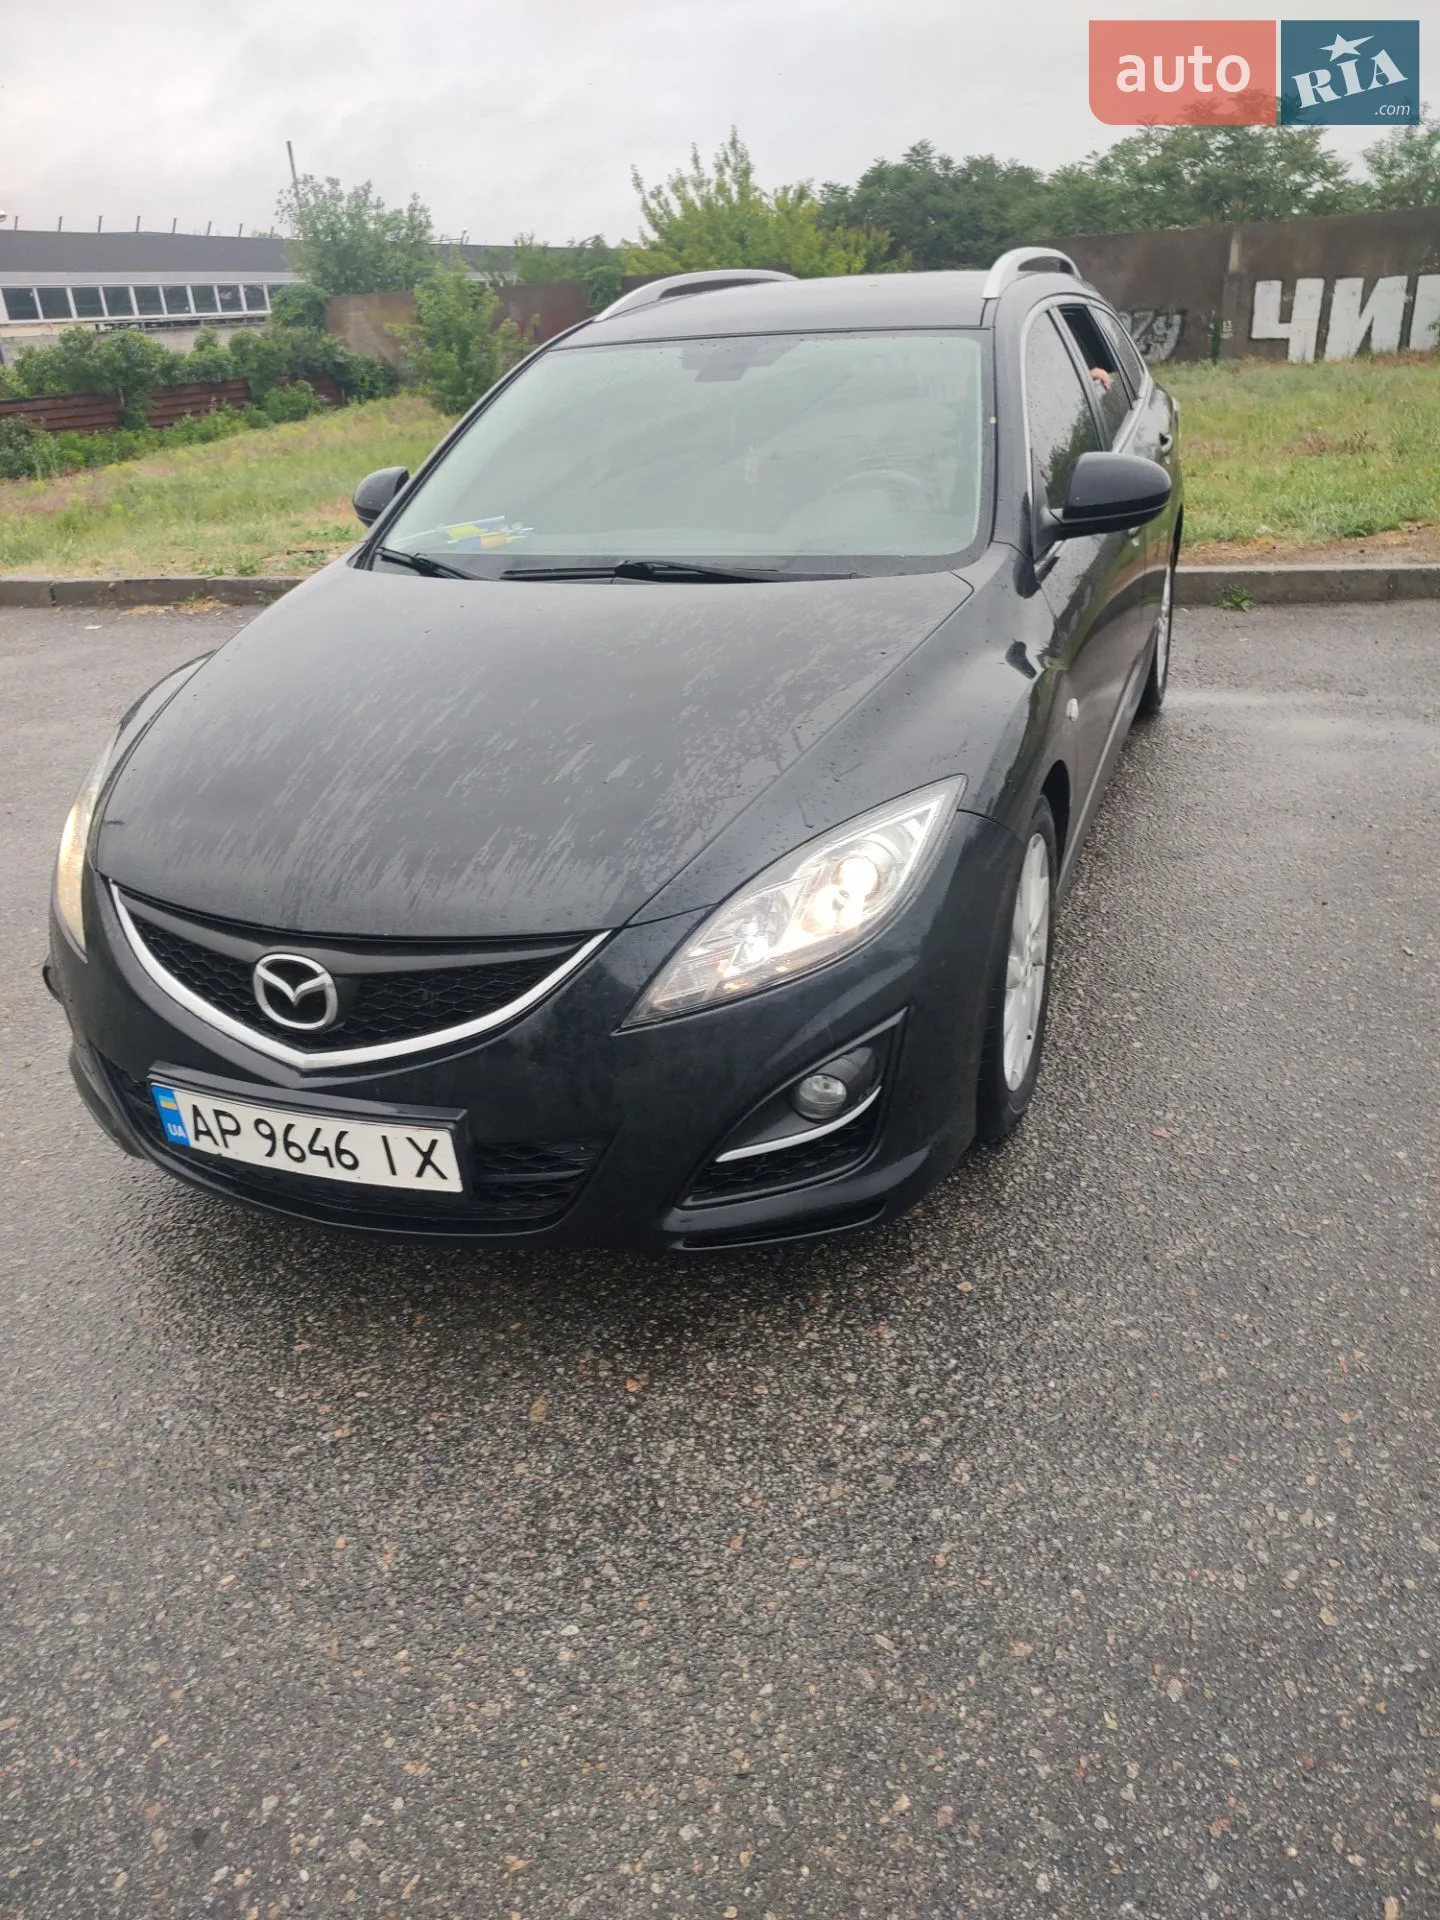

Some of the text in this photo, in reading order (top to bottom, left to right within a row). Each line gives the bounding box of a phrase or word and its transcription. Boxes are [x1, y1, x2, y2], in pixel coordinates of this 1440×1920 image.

[167, 1123, 187, 1138] UA
[191, 1104, 449, 1180] AP 9646 IX
